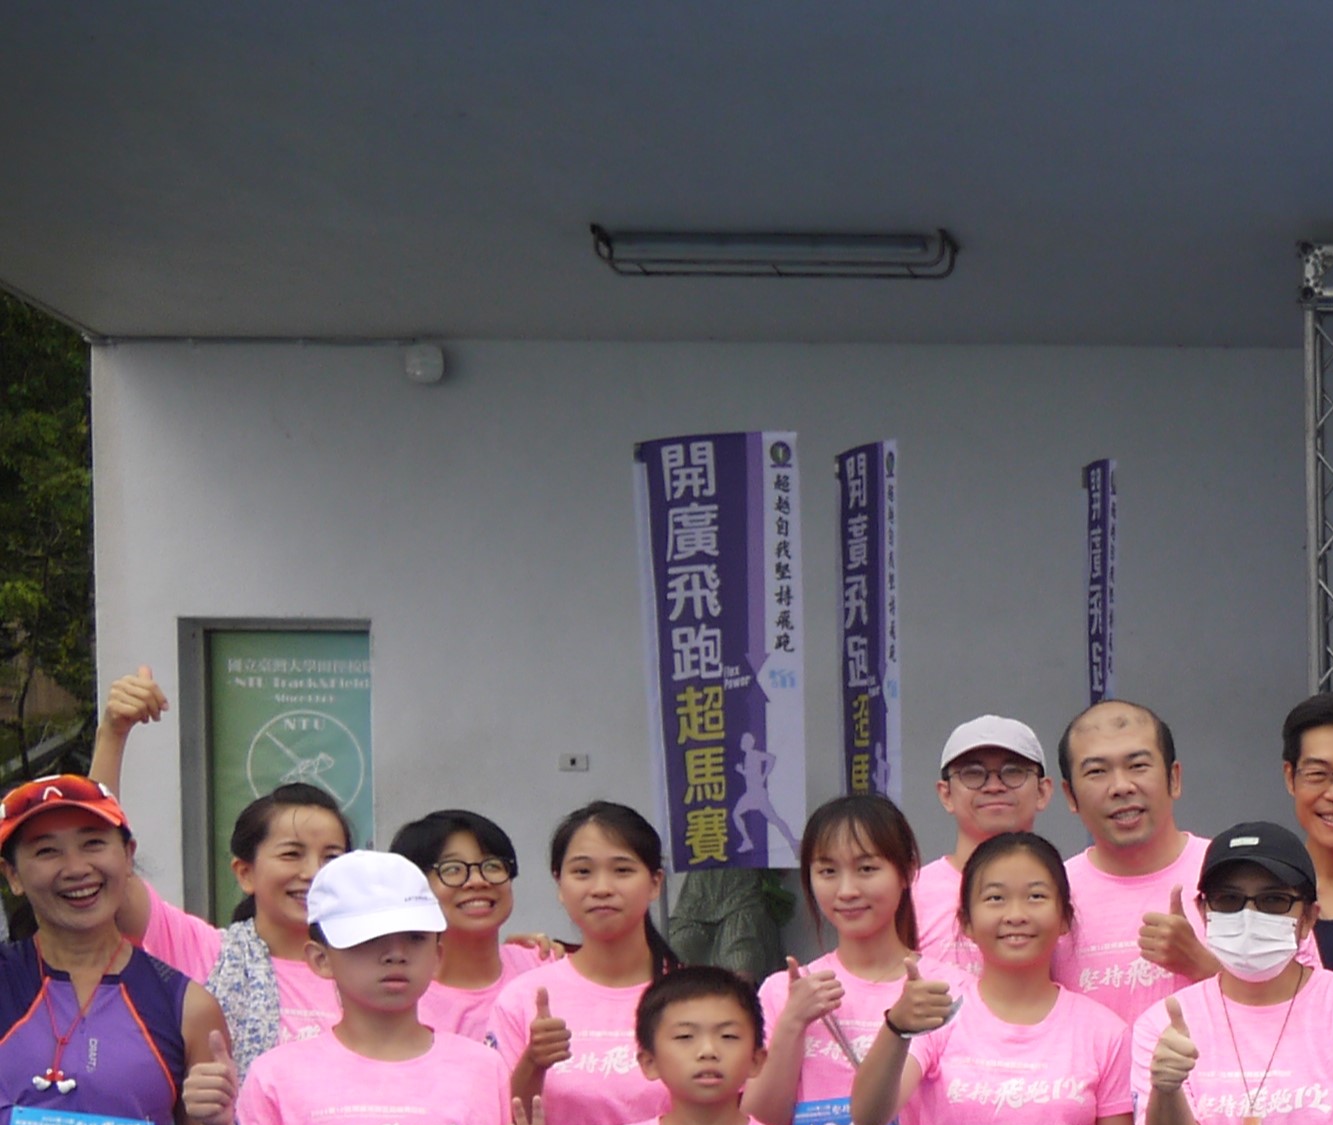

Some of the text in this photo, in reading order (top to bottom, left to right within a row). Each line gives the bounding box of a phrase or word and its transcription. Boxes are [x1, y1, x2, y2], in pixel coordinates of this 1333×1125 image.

[284, 717, 326, 731] NTU
[660, 440, 729, 865] 開廣飛跑超馬賽
